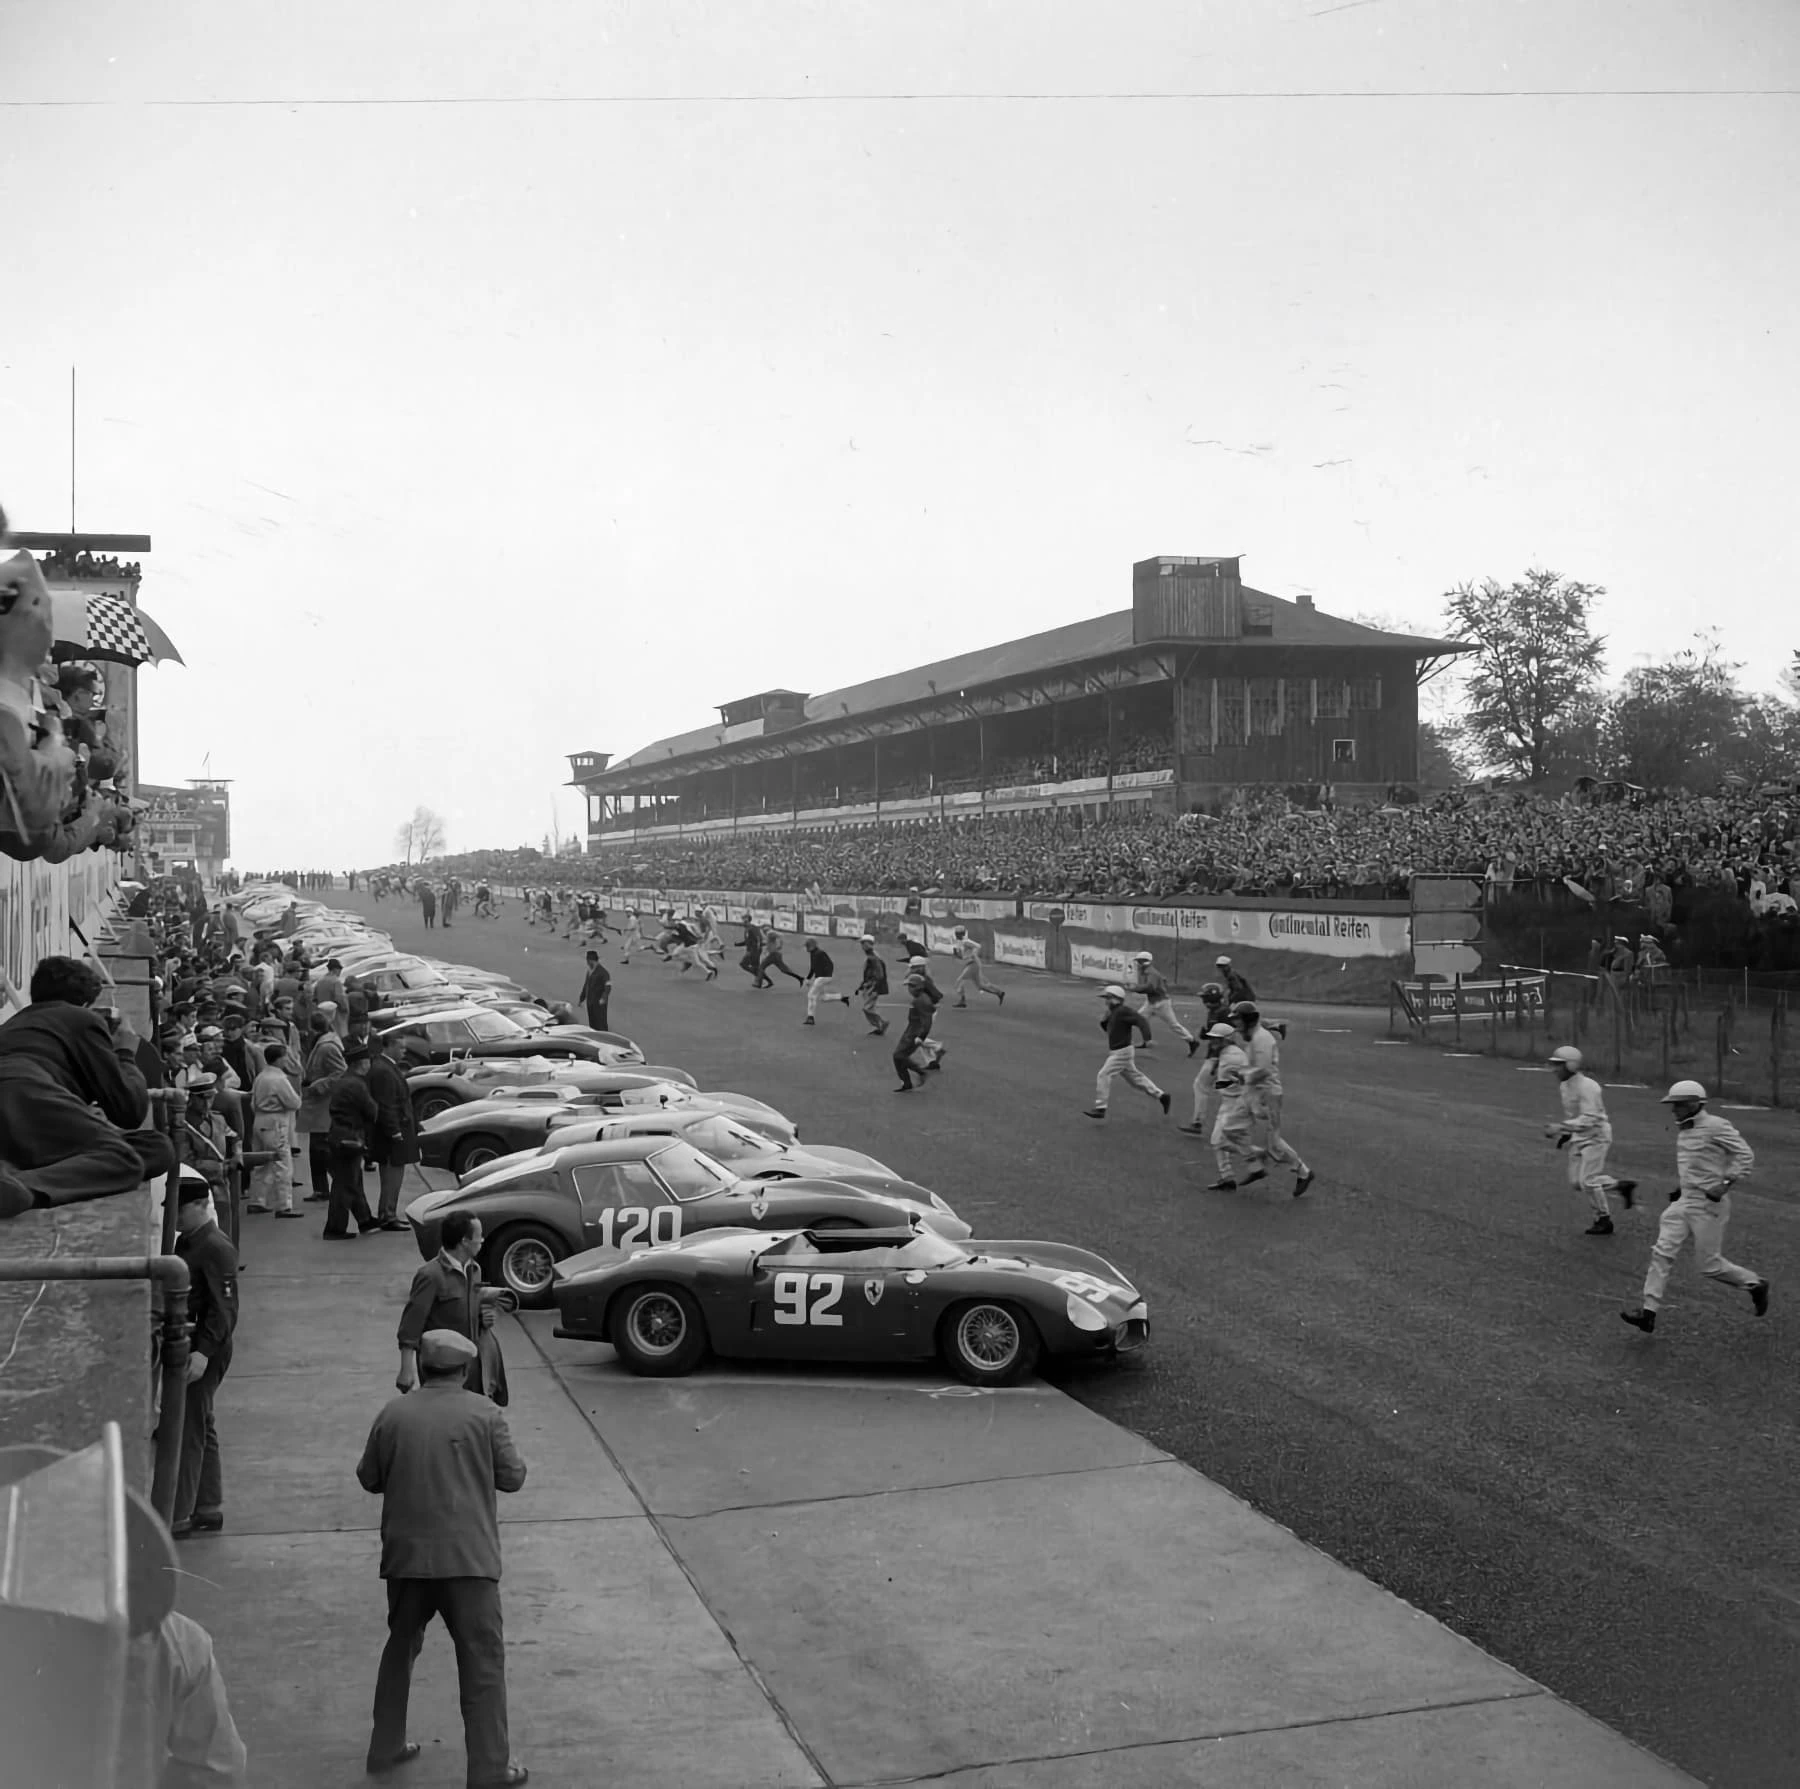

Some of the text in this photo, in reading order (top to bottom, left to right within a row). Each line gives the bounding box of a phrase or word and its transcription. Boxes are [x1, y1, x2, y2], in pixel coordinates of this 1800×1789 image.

[1268, 912, 1371, 940] Continental Reifen
[598, 1204, 682, 1250] 120
[774, 1272, 845, 1326] 92
